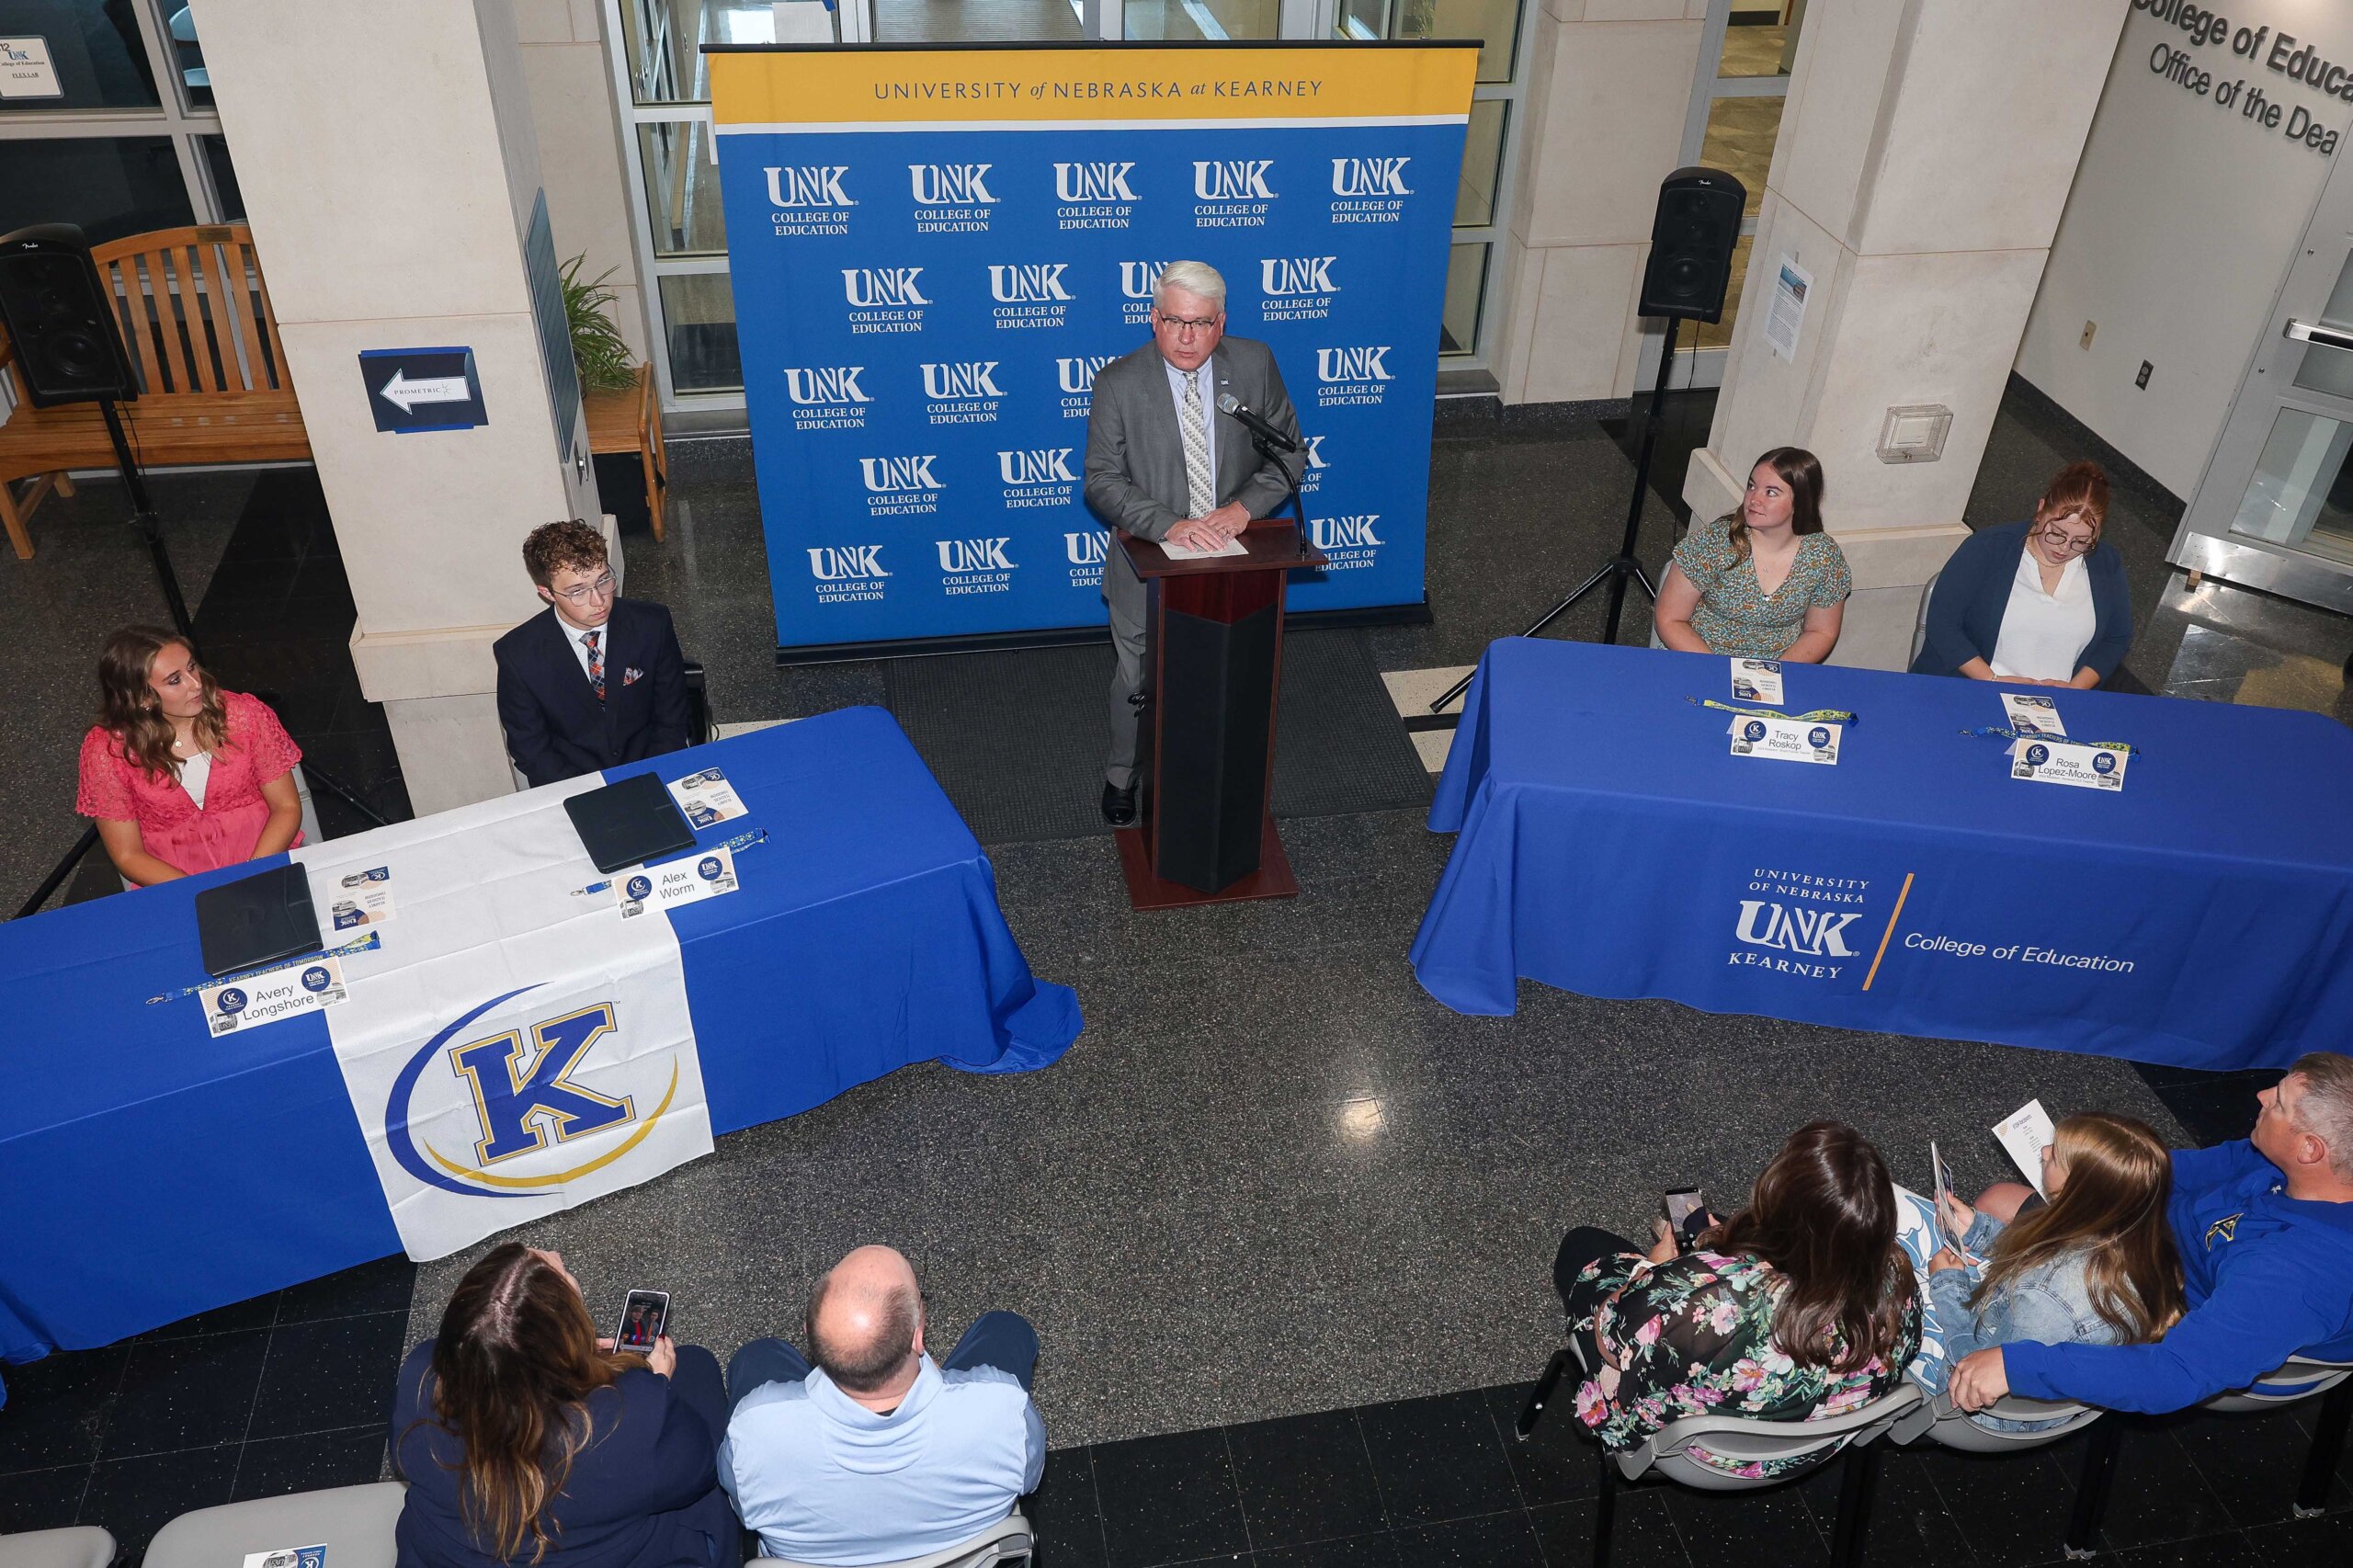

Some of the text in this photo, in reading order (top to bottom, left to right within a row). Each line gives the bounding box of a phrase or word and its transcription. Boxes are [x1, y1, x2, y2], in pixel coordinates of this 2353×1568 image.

[2233, 26, 2269, 60] of
[2267, 32, 2353, 102] Educa
[874, 80, 1324, 100] UNIVERSITY of NEBRASKA at KEARNEY
[2150, 43, 2340, 155] Office of the Dea
[1052, 162, 1138, 202] UNK
[1192, 160, 1275, 200] UNK
[1331, 156, 1411, 197] UNK
[763, 165, 855, 208] UNK
[907, 164, 996, 205] UNK
[1057, 206, 1132, 218] COLLEGE OF
[1194, 203, 1268, 216] COLLEGE OF
[1330, 200, 1404, 211] COLLEGE OF
[771, 211, 849, 223] COLLEGE OF
[914, 209, 991, 221] COLLEGE OF
[1331, 212, 1400, 223] EDUCATION
[916, 221, 989, 233] EDUCATION
[1059, 218, 1130, 230] EDUCATION
[1196, 216, 1266, 228] EDUCATION
[774, 224, 848, 236] EDUCATION
[987, 263, 1072, 302] UNK
[1119, 261, 1169, 299] UN
[1260, 256, 1337, 296] UNK
[841, 267, 928, 307] UNK
[1122, 303, 1152, 312] COLL
[1261, 297, 1332, 310] COLLEGE OF
[848, 310, 924, 323] COLLEGE OF
[993, 305, 1066, 317] COLLEGE OF
[1263, 309, 1328, 322] EDUCATION
[852, 322, 922, 334] EDUCATION
[995, 317, 1064, 329] EDUCATION
[1316, 346, 1396, 382] UNK
[783, 366, 870, 404] UNK
[919, 361, 1004, 400] UNK
[393, 387, 441, 395] PROMETRIC
[1317, 384, 1386, 396] COLLEGE OF
[926, 401, 999, 414] COLLEGE OF
[1061, 397, 1091, 407] COLL
[1319, 395, 1382, 407] EDUCATION
[792, 407, 866, 419] COLLEGE OF
[929, 413, 997, 425] EDUCATION
[795, 418, 865, 430] EDUCATION
[996, 448, 1077, 484] UNK
[858, 455, 942, 492] UNK
[1307, 472, 1322, 482] OF
[1003, 485, 1073, 498] COLLEGE OF
[867, 493, 938, 506] COLLEGE OF
[1006, 496, 1071, 508] EDUCATION
[870, 504, 937, 517] EDUCATION
[1310, 515, 1381, 550] UNK
[1063, 530, 1111, 564] UN
[935, 537, 1015, 573] UNK
[1324, 550, 1377, 562] LLEGE OF
[806, 544, 889, 580] UNK
[1069, 566, 1105, 577] COLLE
[942, 573, 1011, 585] COLLEGE OF
[815, 581, 885, 594] COLLEGE OF
[945, 583, 1009, 596] EDUCATION
[818, 591, 884, 603] EDUCATION
[1774, 731, 1799, 743] Tracy
[1768, 739, 1802, 751] Roskop
[2056, 757, 2080, 769] Rosa
[2038, 765, 2097, 780] Lopez-Moore
[662, 871, 688, 886] Alex
[1753, 869, 1870, 890] UNIVERSITY
[659, 883, 695, 900] Worm
[1748, 881, 1865, 904] OF NEBRASKA
[1735, 899, 1862, 958] UNK
[1904, 932, 2135, 974] College of Education
[1727, 951, 1844, 980] KEARNEY
[256, 985, 294, 1003] Avery
[243, 995, 314, 1021] Longshore
[447, 1000, 637, 1167] K
